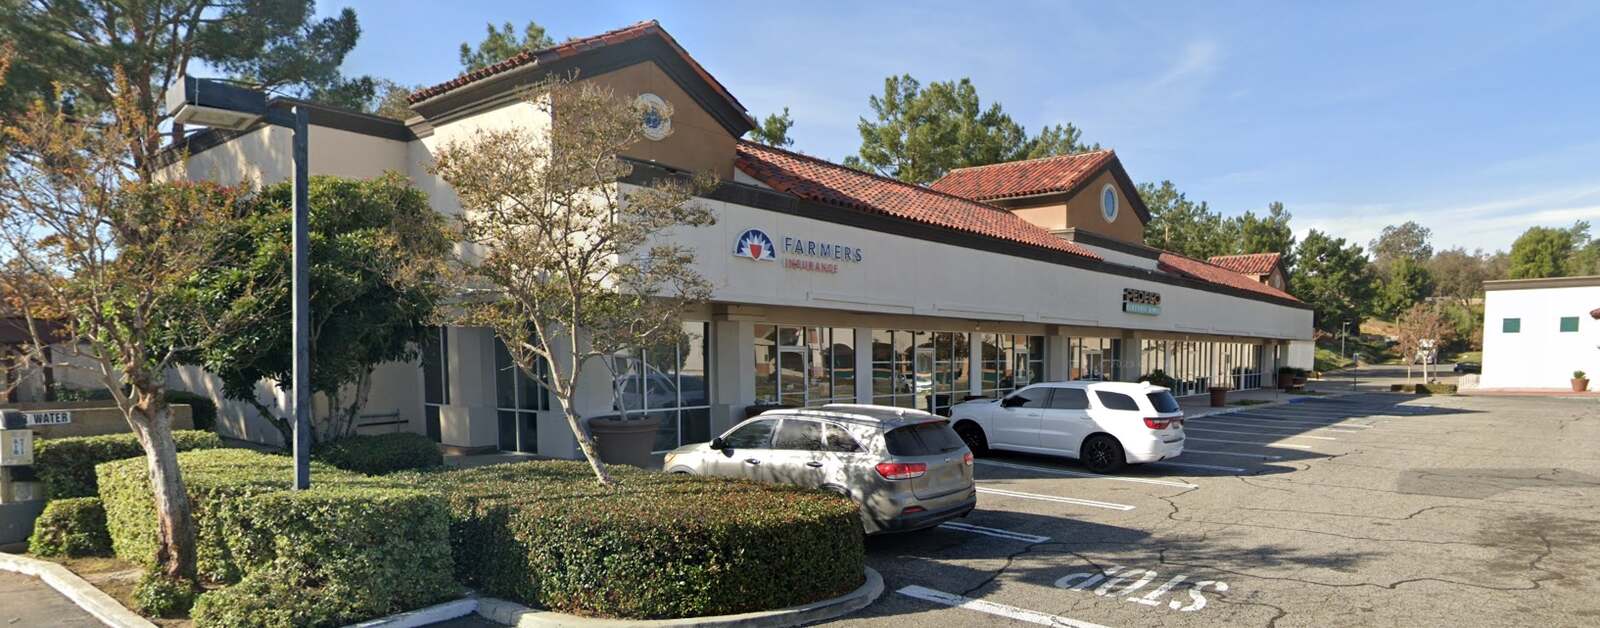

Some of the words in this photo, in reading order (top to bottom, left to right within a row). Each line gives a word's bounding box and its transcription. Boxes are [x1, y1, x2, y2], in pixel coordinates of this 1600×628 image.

[785, 237, 862, 262] FARMERS
[784, 258, 838, 274] INSURANCE
[33, 413, 69, 424] WATER
[1054, 565, 1229, 611] STOP
